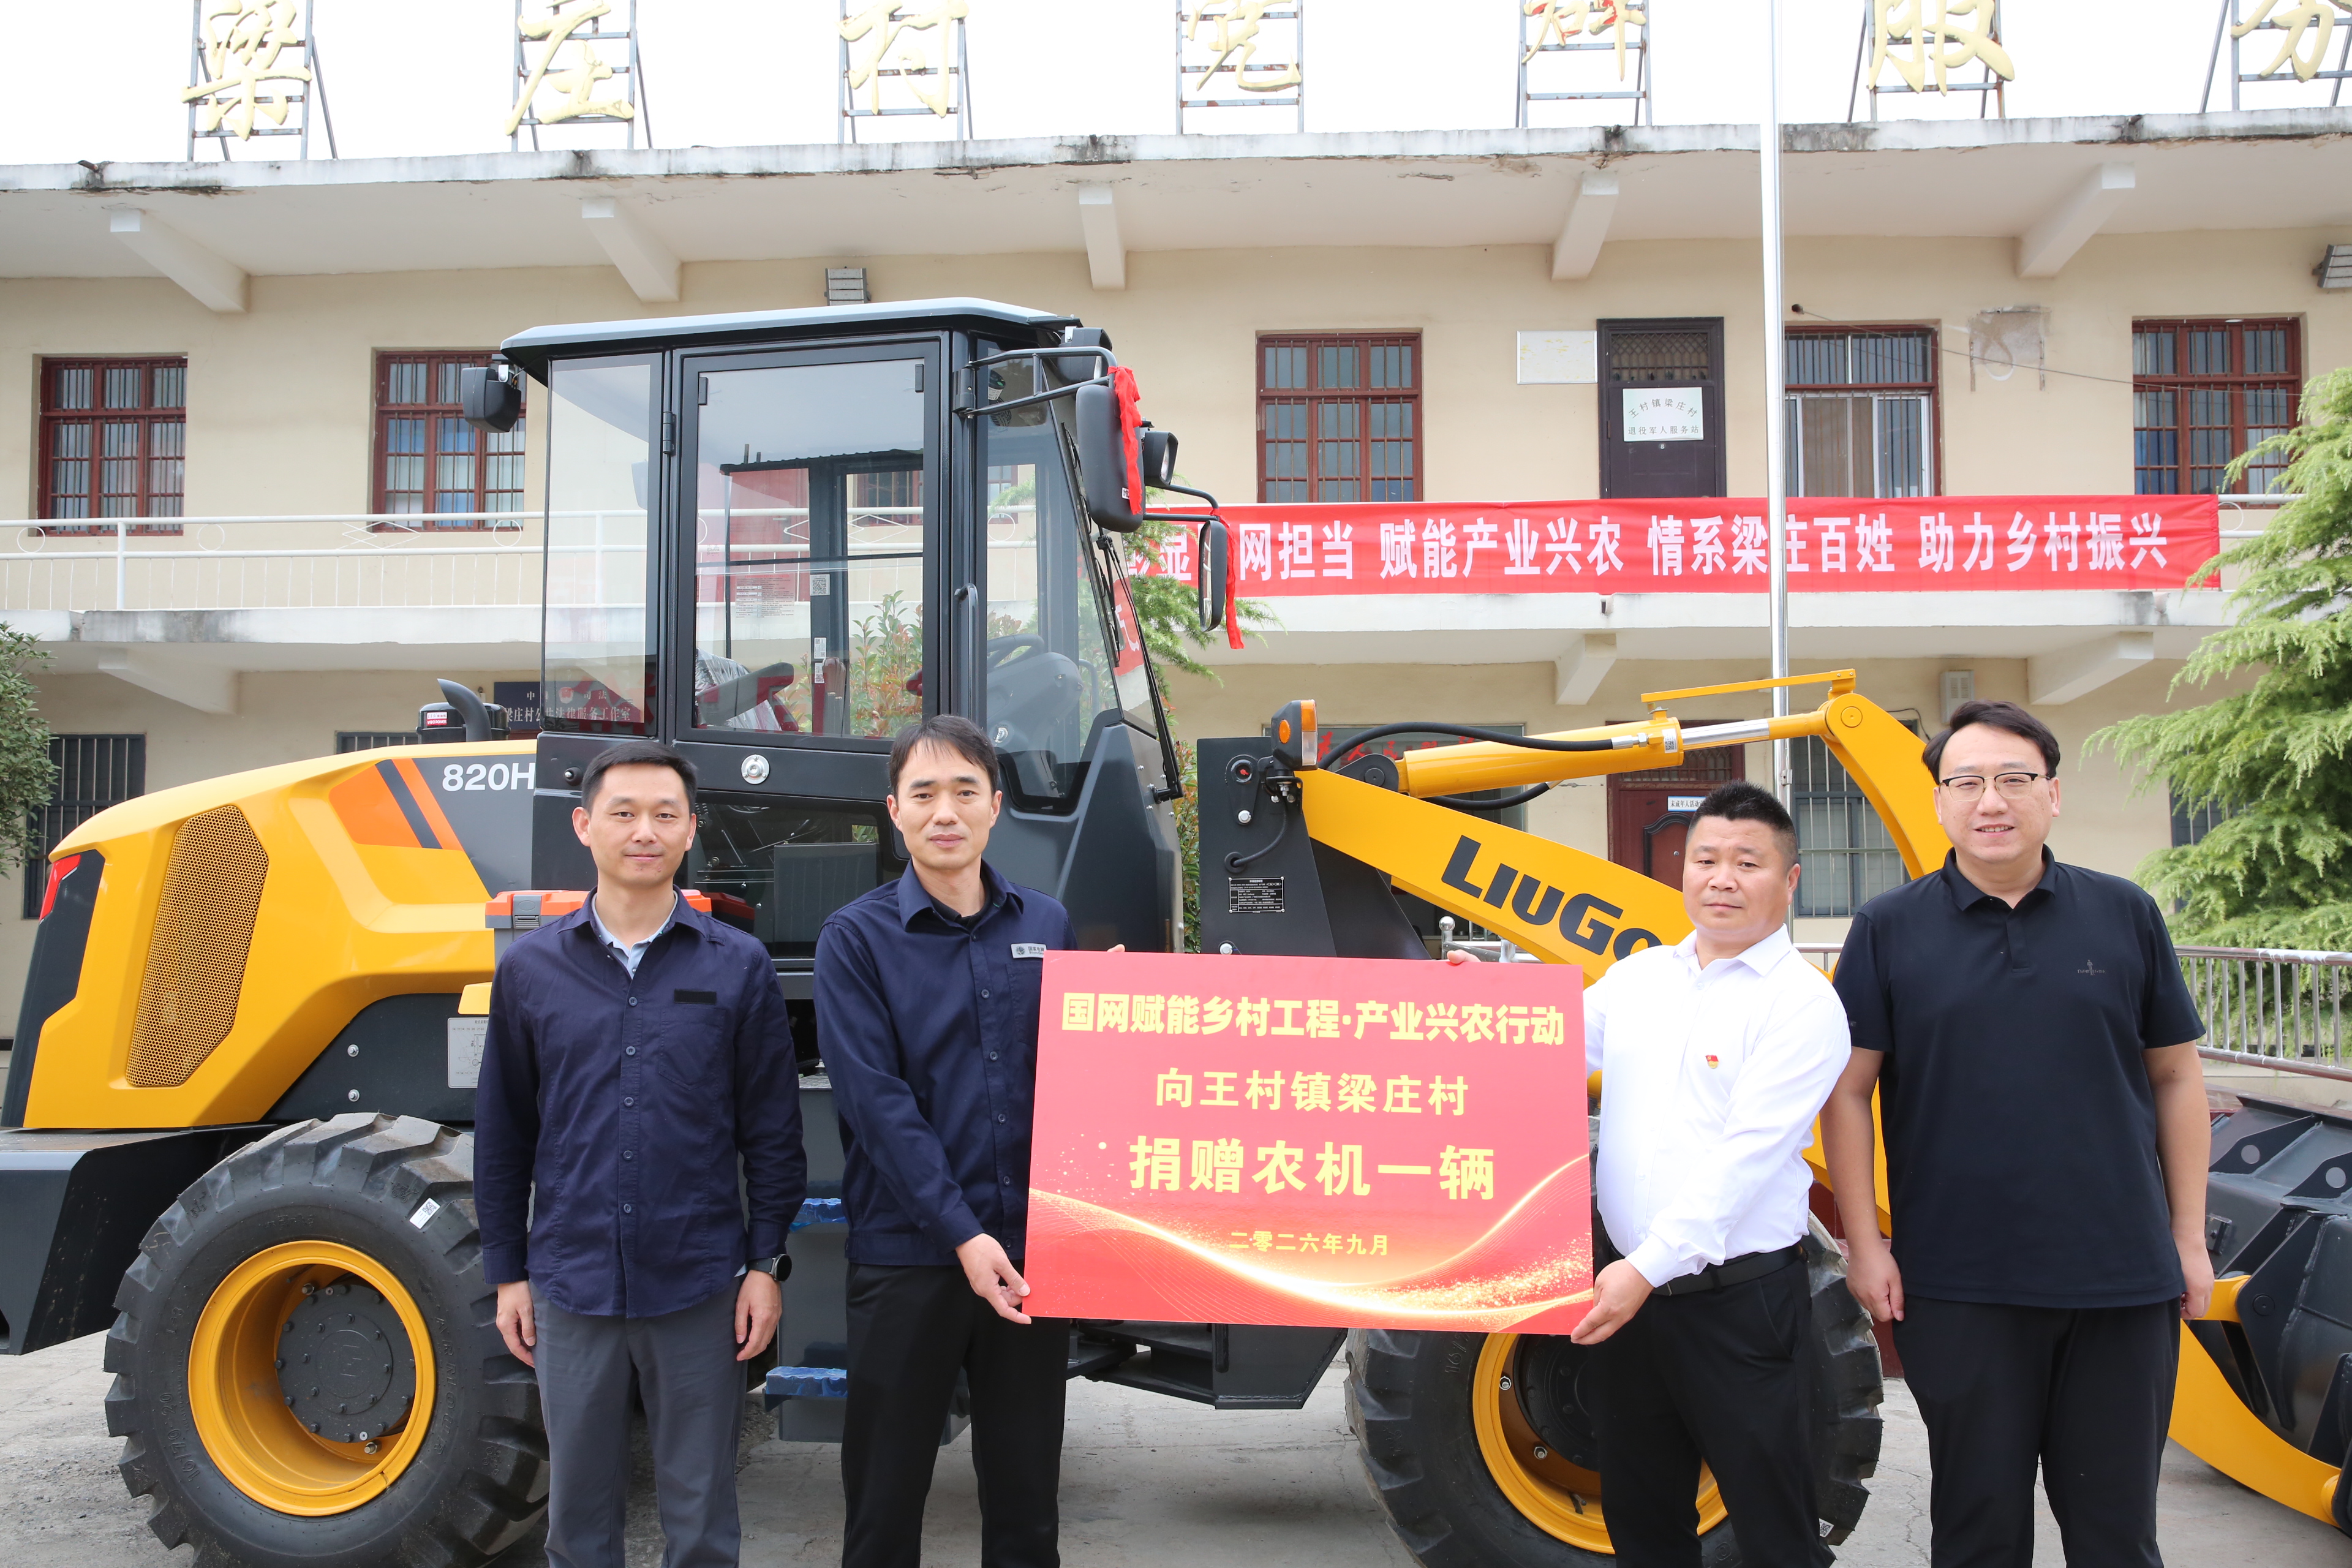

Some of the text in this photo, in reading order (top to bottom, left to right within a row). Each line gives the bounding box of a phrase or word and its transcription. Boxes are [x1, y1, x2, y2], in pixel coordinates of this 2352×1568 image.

[1628, 425, 1699, 435] 退役军人服务站
[1629, 398, 1697, 419] 王村镇梁庄村
[1127, 519, 1353, 581] 显网担当
[1380, 513, 1624, 579] 赋能产业兴农
[1918, 511, 2168, 573] 助力乡村振兴
[442, 763, 535, 791] 820H
[1061, 992, 1565, 1046] 国网赋能乡村工程·产业兴农行动
[1156, 1067, 1469, 1116] 向王村镇梁庄村
[1129, 1135, 1494, 1200] 捐赠农机一辆
[1230, 1231, 1389, 1257] 二零二六年九月
[434, 1316, 458, 1456] ARMOUR
